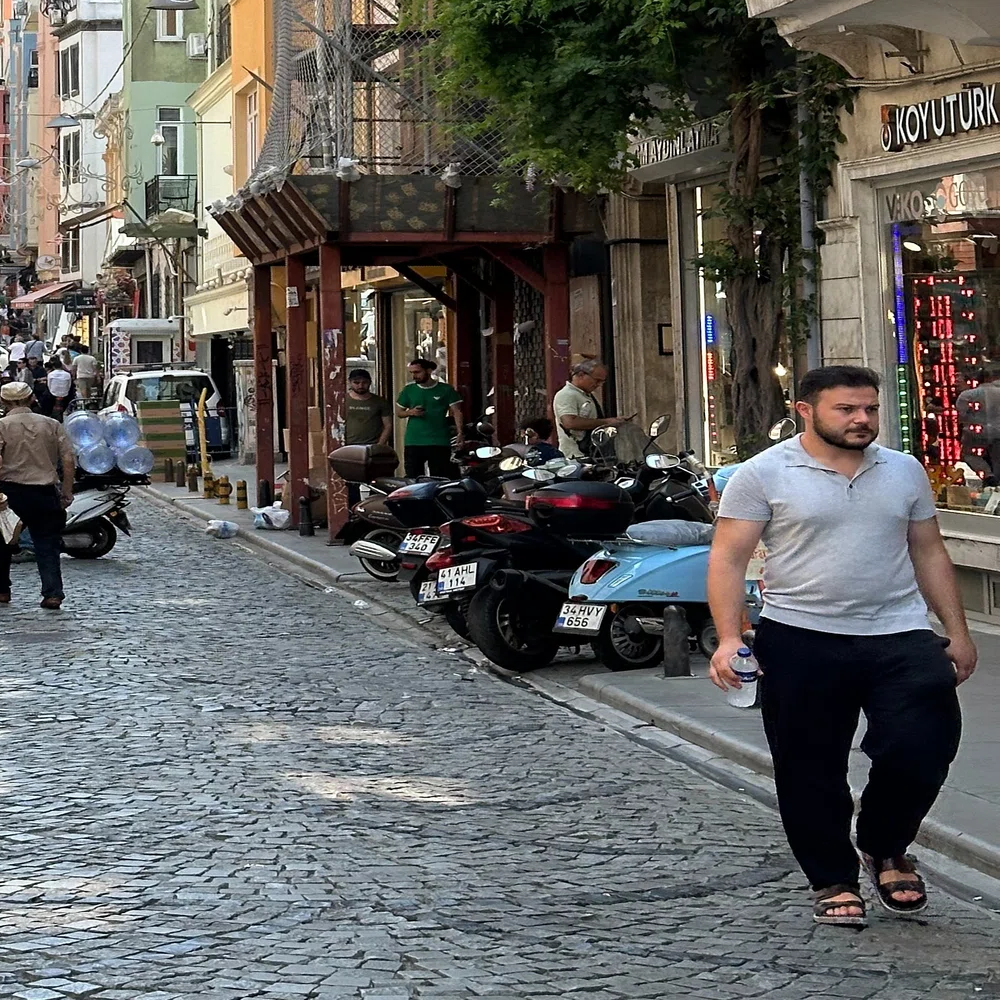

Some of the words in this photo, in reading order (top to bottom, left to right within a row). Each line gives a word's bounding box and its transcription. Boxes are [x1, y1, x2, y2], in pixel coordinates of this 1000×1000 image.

[408, 542, 428, 551] 340
[440, 568, 452, 578] 41
[454, 564, 475, 577] AHL
[421, 582, 432, 592] 21
[449, 577, 466, 587] 114
[562, 605, 577, 615] 34
[579, 605, 603, 617] HVY
[566, 616, 589, 627] 656
